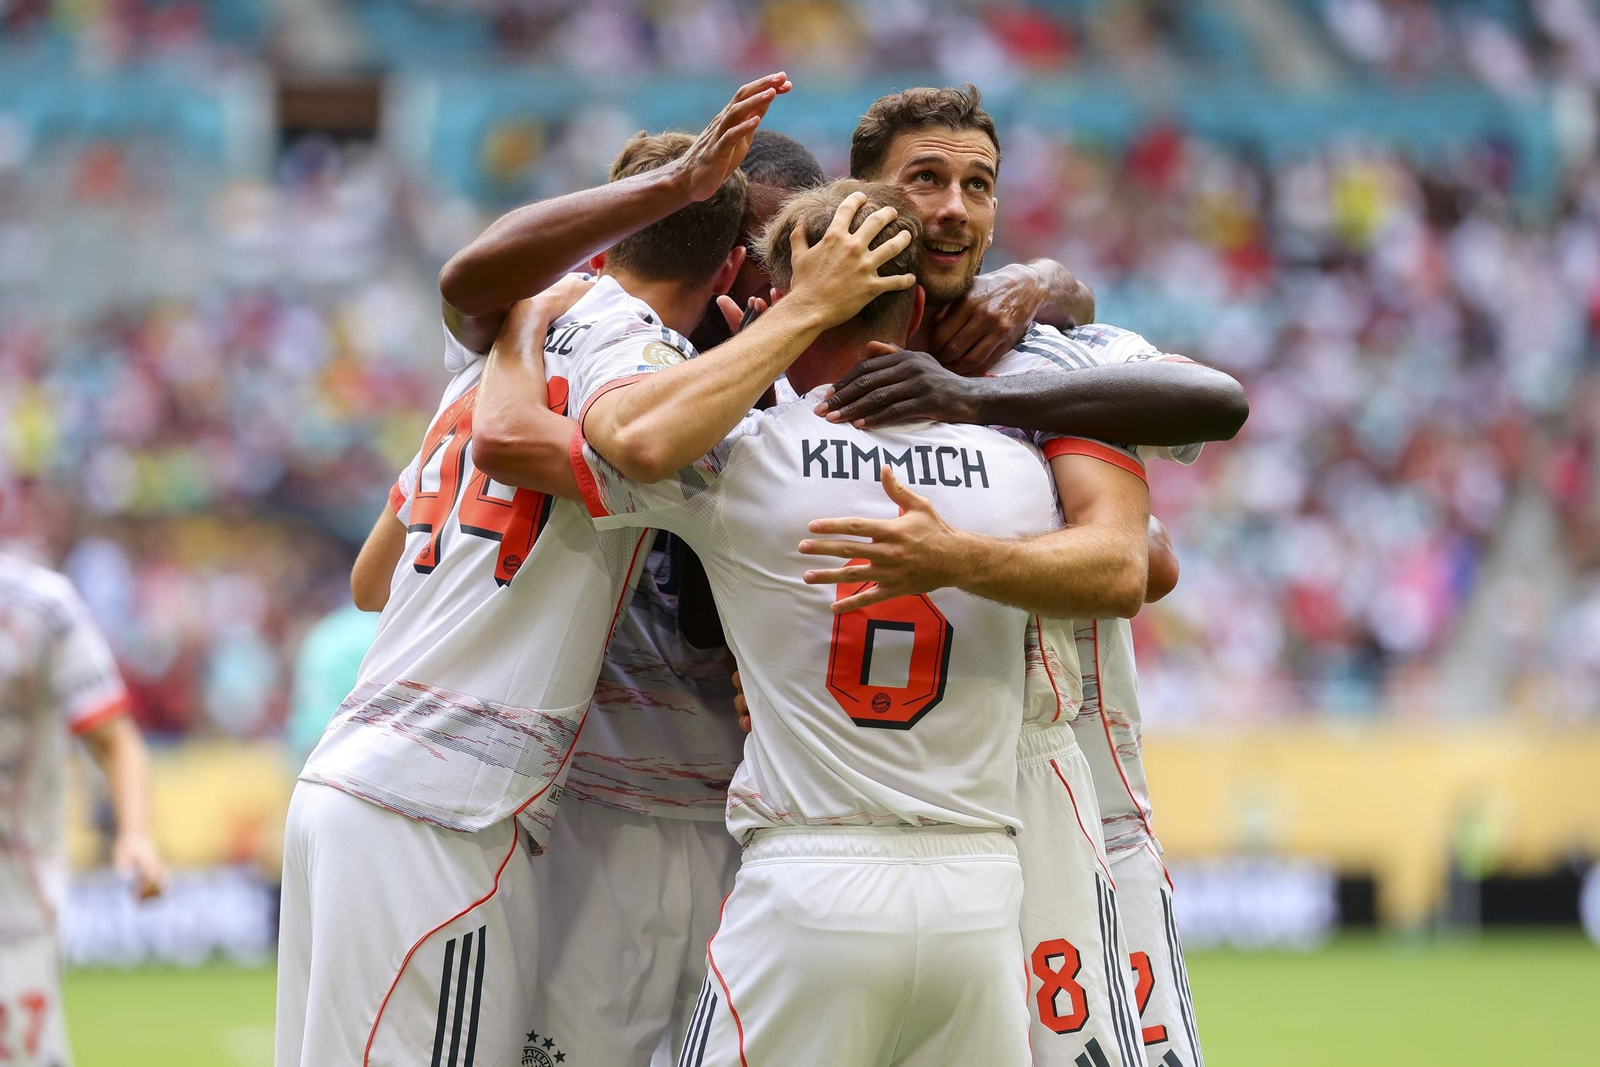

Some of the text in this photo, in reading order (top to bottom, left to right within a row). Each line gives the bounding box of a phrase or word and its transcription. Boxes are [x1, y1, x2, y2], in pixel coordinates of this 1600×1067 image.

[801, 438, 990, 489] KIMMICH
[825, 507, 954, 730] 6
[1031, 938, 1090, 1035] 8
[1129, 950, 1169, 1046] 2
